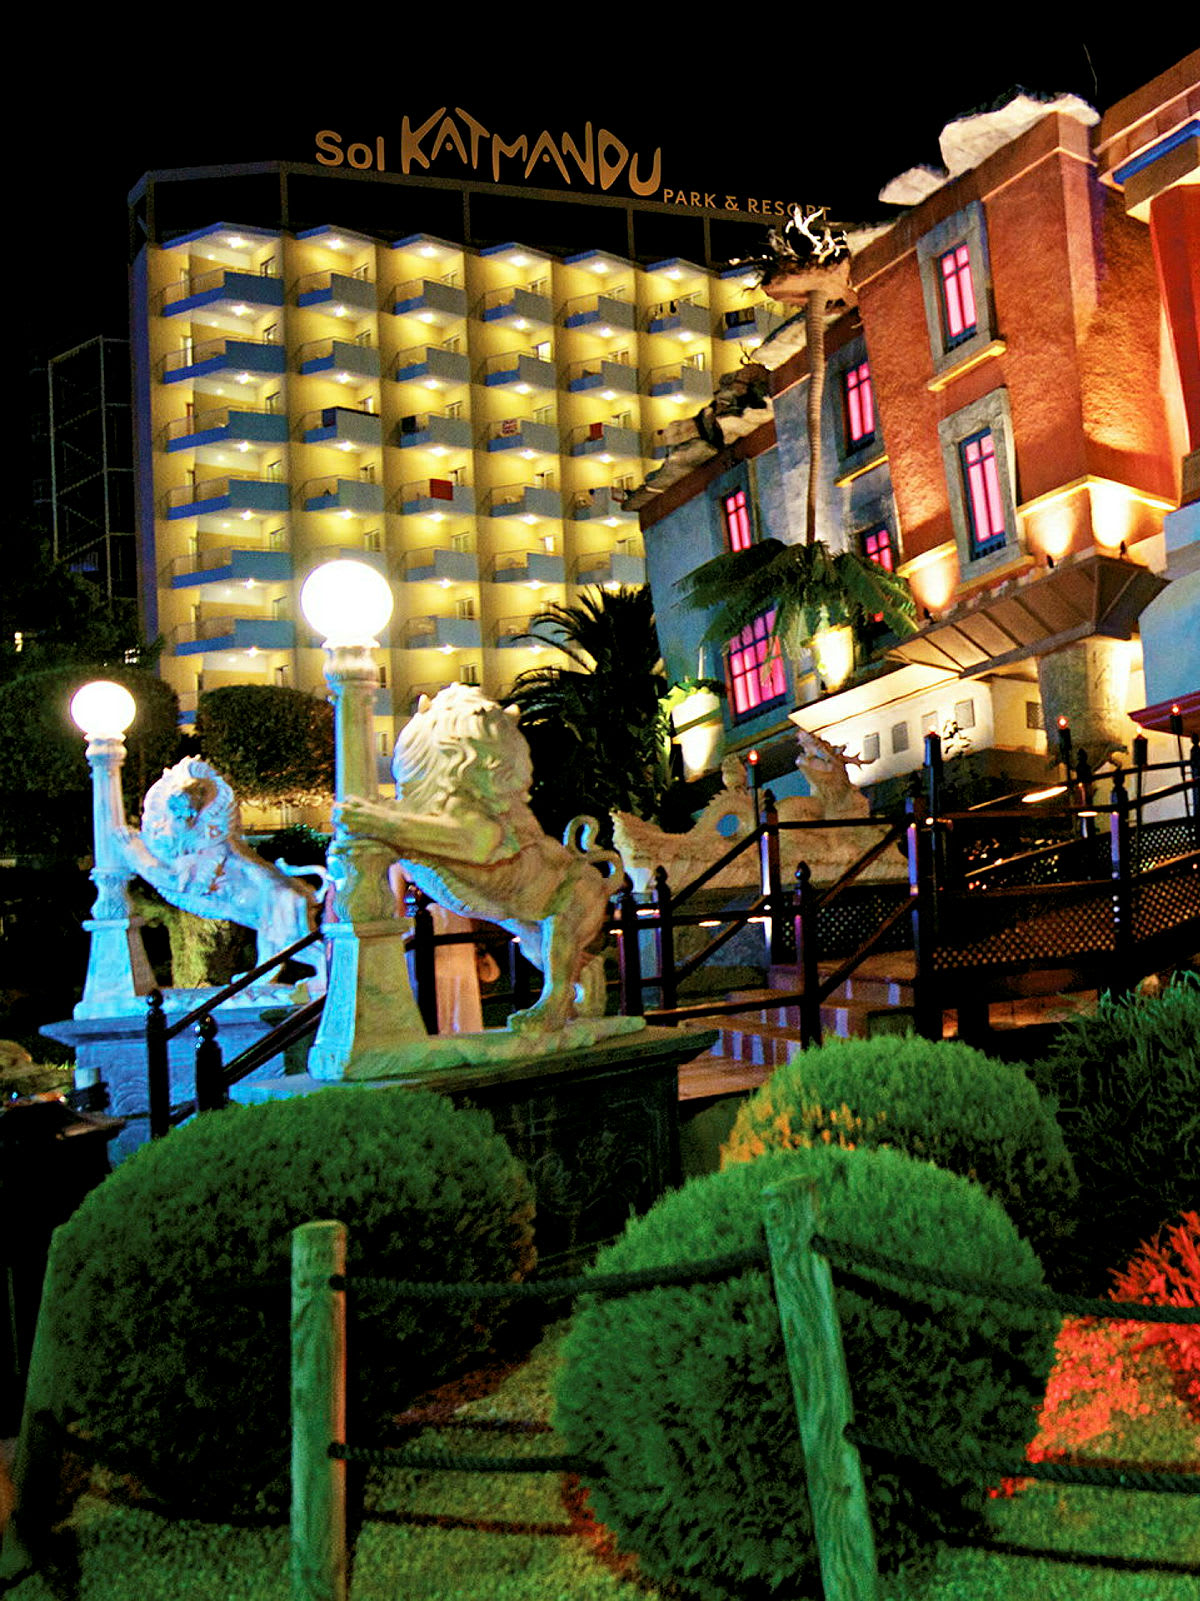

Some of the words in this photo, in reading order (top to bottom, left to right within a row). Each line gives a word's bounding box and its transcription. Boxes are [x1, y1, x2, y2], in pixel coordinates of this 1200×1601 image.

[315, 129, 385, 171] Sol
[401, 106, 662, 196] KATMANDU
[663, 188, 717, 209] PARK
[724, 195, 740, 212] &
